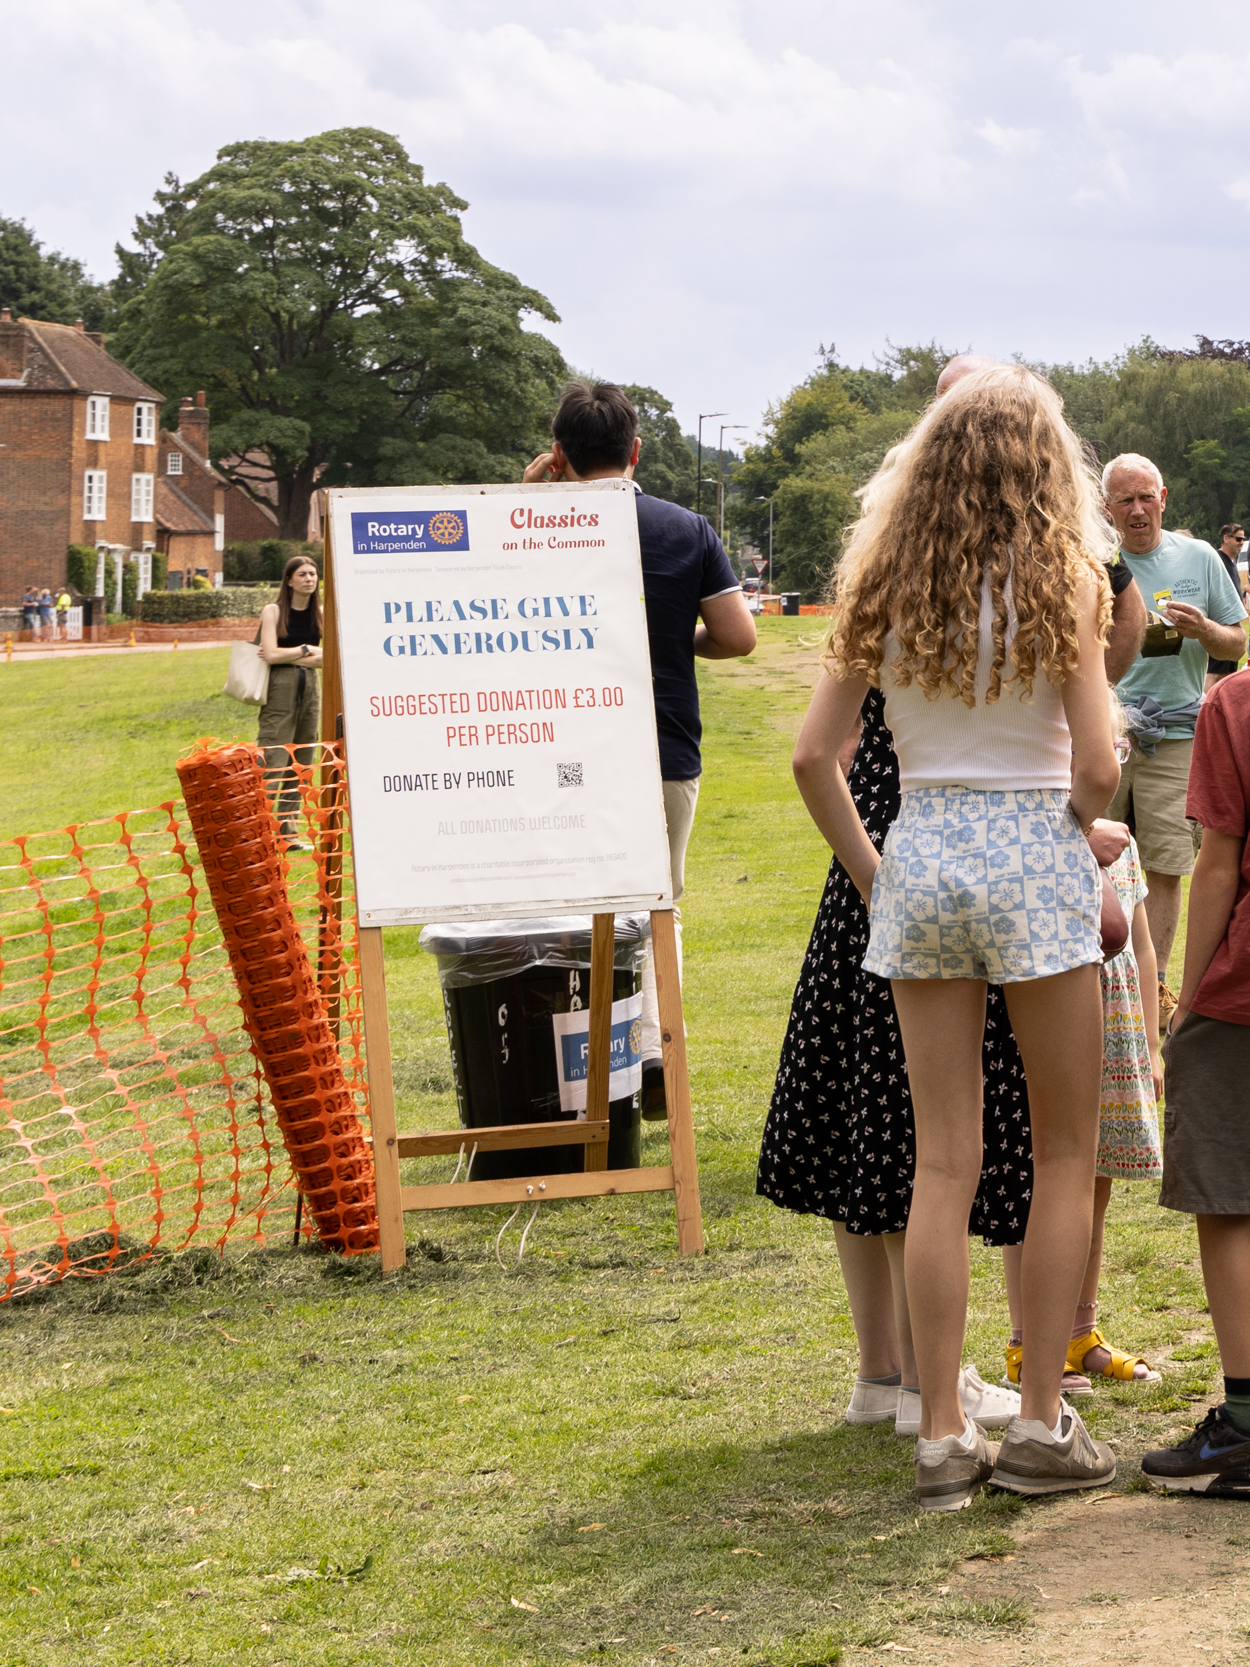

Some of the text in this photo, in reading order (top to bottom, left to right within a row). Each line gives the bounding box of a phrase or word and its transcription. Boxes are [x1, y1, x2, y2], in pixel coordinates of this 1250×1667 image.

[510, 507, 599, 529] Classics
[368, 521, 424, 539] Rotary
[358, 538, 426, 552] in Harpenden
[503, 536, 605, 551] on the Common
[383, 594, 598, 624] PLEASE GIVE
[383, 627, 600, 657] GENEROUSLY
[370, 686, 624, 718] SUGGESTED DONATION £3.00
[447, 721, 556, 748] PER PERSON
[383, 769, 516, 793] DONATE BY PHONE
[438, 814, 587, 836] ALL DONATIONS WELCOME
[411, 863, 431, 873] Rotary
[431, 863, 438, 871] in
[438, 861, 470, 872] Harpenden
[481, 860, 511, 869] charitable
[511, 858, 549, 868] incorporated
[549, 856, 585, 866] organisation
[586, 856, 597, 864] reg
[580, 1037, 626, 1060] Rary
[570, 1067, 579, 1077] in
[926, 1442, 941, 1451] new
